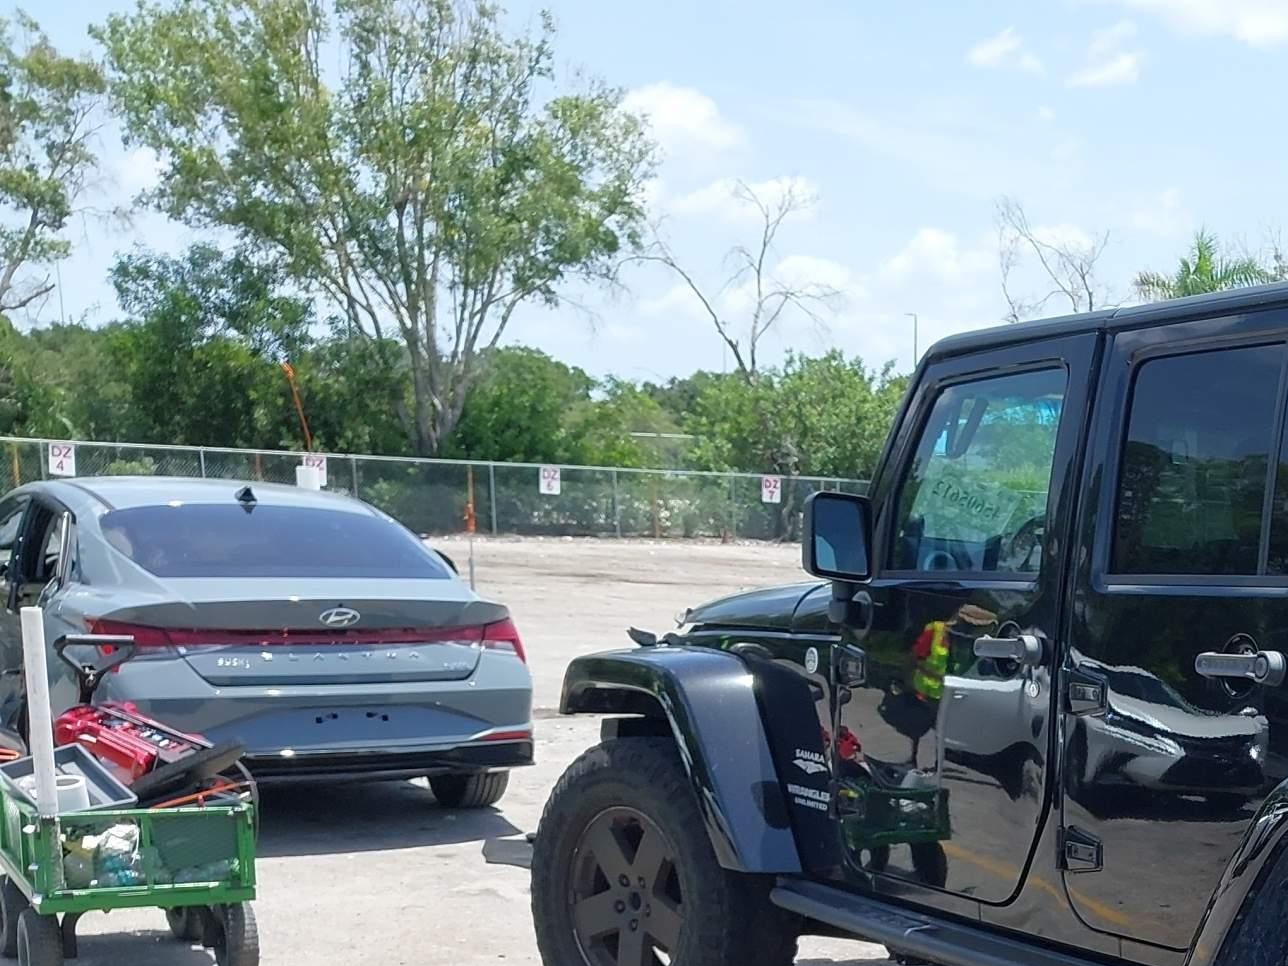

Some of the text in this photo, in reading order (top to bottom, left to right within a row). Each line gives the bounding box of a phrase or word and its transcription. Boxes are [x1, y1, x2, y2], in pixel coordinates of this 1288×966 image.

[52, 445, 72, 459] DZ
[56, 460, 64, 472] 4
[543, 467, 559, 481] DZ
[546, 481, 554, 492] 6
[765, 479, 780, 490] DZ
[768, 490, 776, 500] 7
[795, 748, 826, 764] SAHARA
[786, 783, 832, 803] WRANGLER
[794, 796, 829, 812] UNLIMITED
